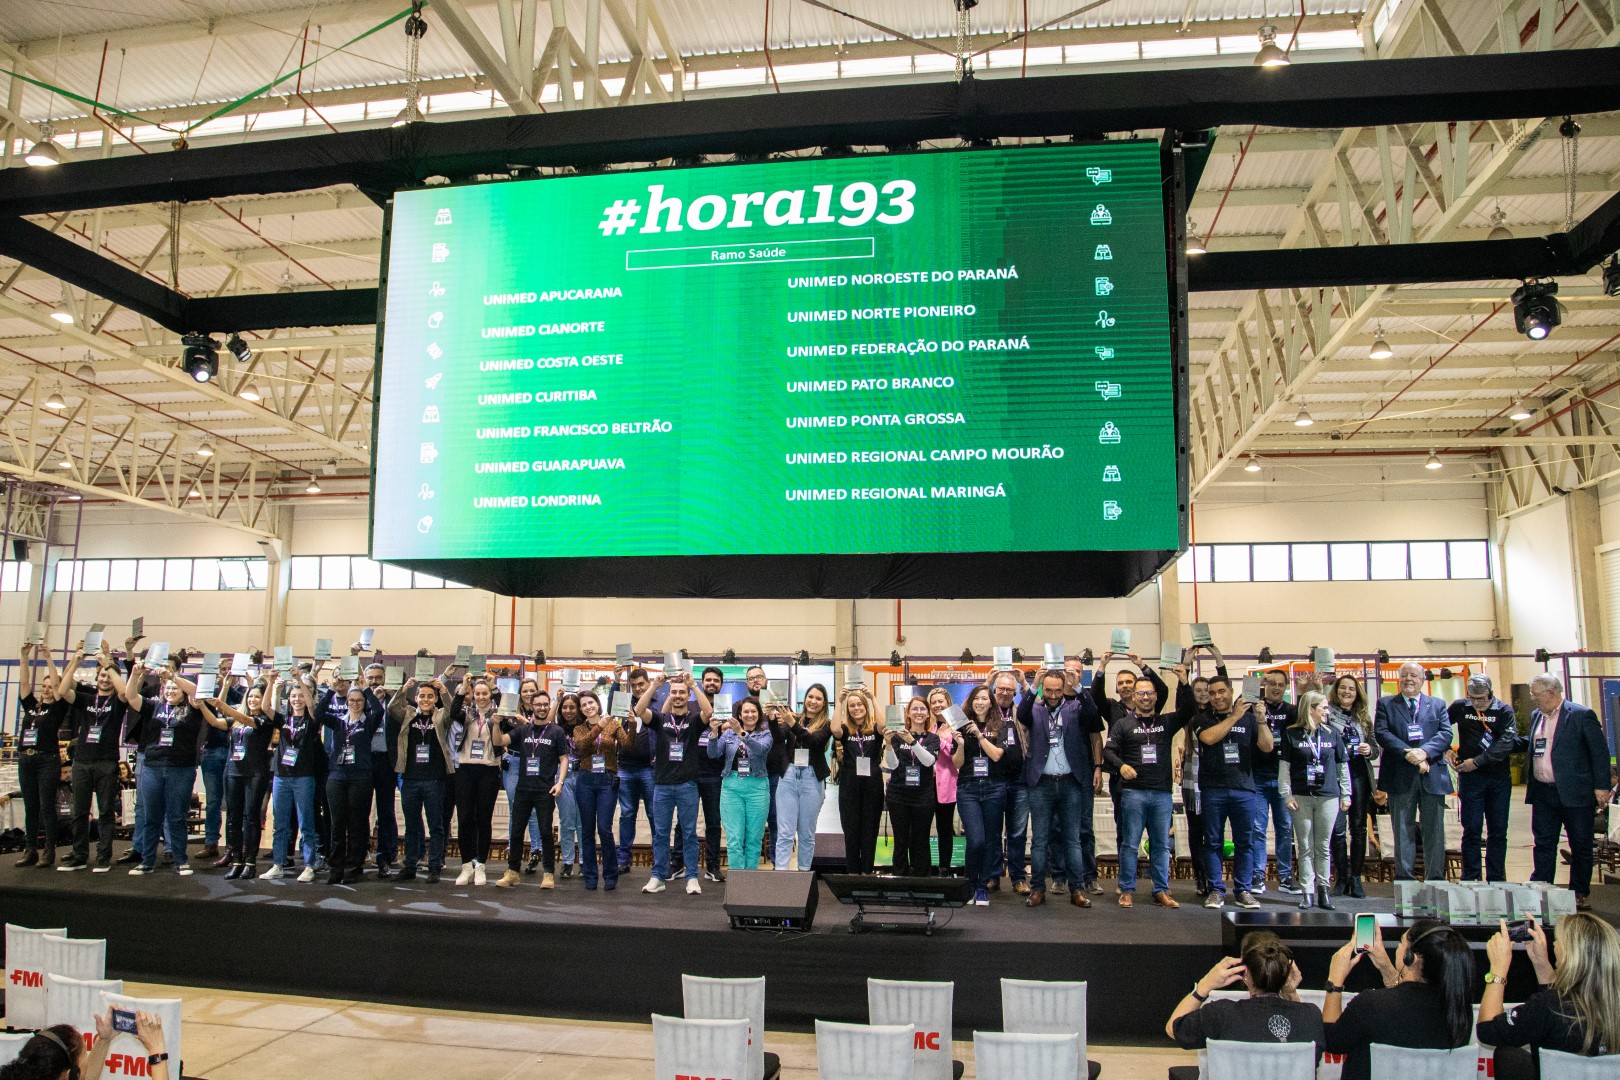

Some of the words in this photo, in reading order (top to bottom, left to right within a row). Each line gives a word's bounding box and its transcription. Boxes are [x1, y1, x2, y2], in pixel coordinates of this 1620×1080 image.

[598, 179, 917, 236] #hora193
[711, 249, 746, 261] Ramo
[748, 247, 786, 260] Saúde
[788, 274, 848, 288] UNIMED
[851, 271, 928, 286] NOROESTE
[931, 270, 954, 283] DO
[957, 265, 1018, 281] PARANÁ
[483, 292, 537, 306] UNIMED
[539, 286, 622, 303] APUCARANA
[787, 309, 848, 323] UNIMED
[851, 306, 900, 321] NORTE
[903, 304, 976, 318] PIONEIRO
[481, 325, 535, 339] UNIMED
[538, 321, 605, 335] CIANORTE
[787, 344, 847, 358] UNIMED
[851, 338, 937, 357] FEDERAÇÃO
[941, 340, 964, 353] DO
[968, 335, 1030, 351] PARANÁ
[480, 359, 534, 372] UNIMED
[537, 357, 578, 369] COSTA
[581, 354, 623, 367] OESTE
[786, 379, 847, 393] UNIMED
[851, 377, 888, 390] PATO
[892, 376, 954, 389] BRANCO
[478, 392, 532, 405] UNIMED
[535, 389, 597, 403] CURITIBA
[476, 426, 530, 439] UNIMED
[533, 423, 608, 437] FRANCISCO
[612, 419, 672, 434] BELTRÃO
[786, 415, 847, 429] UNIMED
[851, 413, 901, 427] PONTA
[904, 411, 965, 425] GROSSA
[785, 451, 847, 465] UNIMED
[851, 449, 927, 463] REGIONAL
[930, 447, 987, 460] CAMPO
[991, 444, 1065, 460] MOURÃO
[475, 460, 529, 473] UNIMED
[532, 457, 625, 471] GUARAPUAVA
[474, 495, 528, 508] UNIMED
[531, 493, 601, 506] LONDRINA
[785, 488, 847, 501] UNIMED
[851, 486, 927, 500] REGIONAL
[930, 483, 1006, 498] MARINGÁ
[105, 1053, 153, 1077] FM
